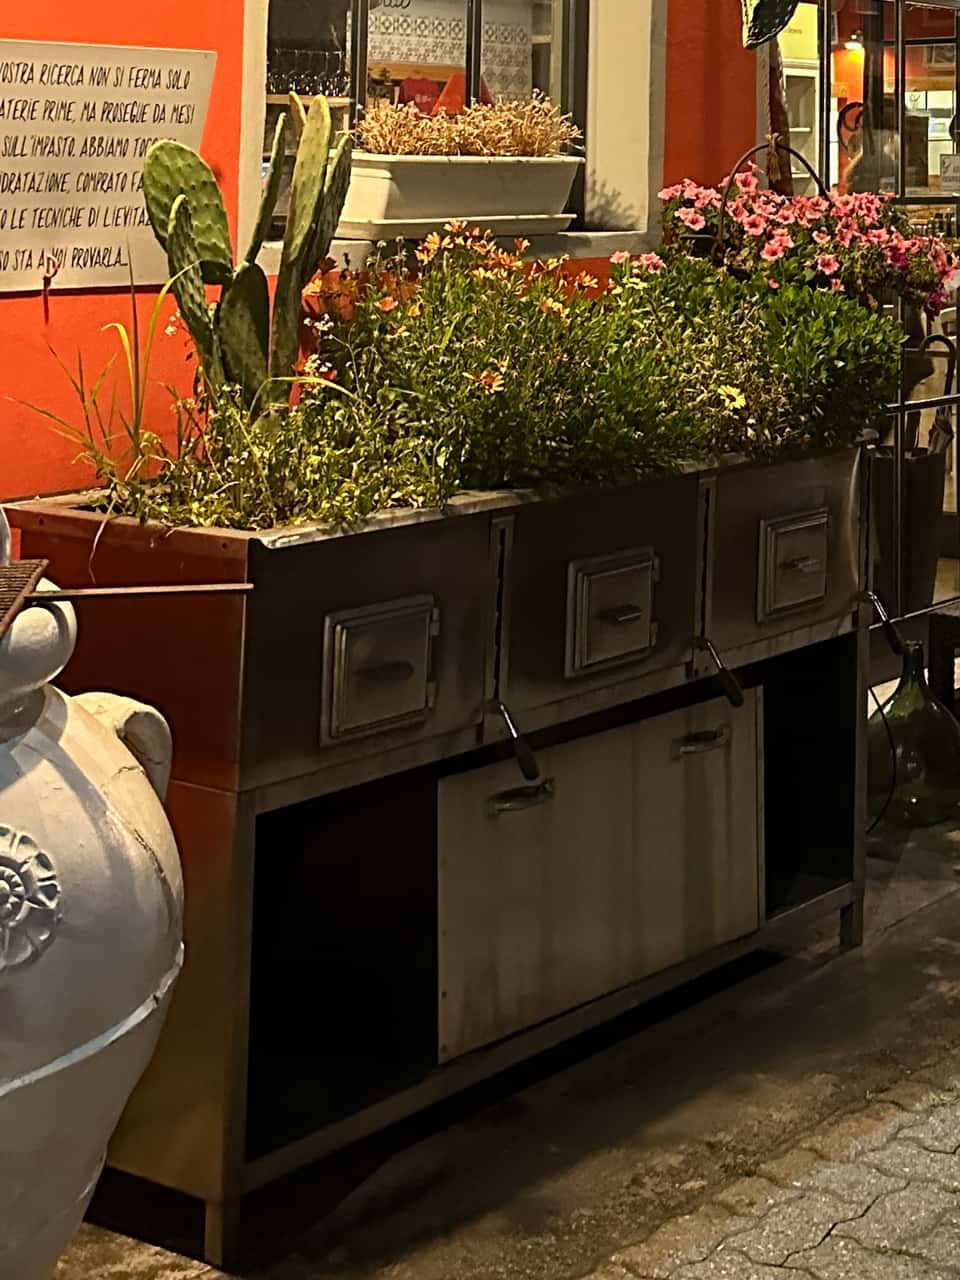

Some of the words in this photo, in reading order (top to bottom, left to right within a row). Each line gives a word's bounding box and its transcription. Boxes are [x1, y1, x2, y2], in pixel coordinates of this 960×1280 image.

[39, 64, 84, 86] RICERCA
[89, 66, 111, 87] NON
[113, 66, 124, 88] SI
[128, 67, 161, 89] FERMA
[166, 68, 191, 90] SOLO
[80, 101, 96, 122] MA
[101, 101, 150, 124] PROSEGUE
[153, 104, 166, 124] DA
[169, 104, 196, 125] MESI
[79, 136, 130, 158] ABBIAMO
[0, 171, 71, 195] DRATAZIONE,
[76, 172, 128, 194] COMPRATO
[11, 207, 28, 230] LE
[32, 206, 85, 229] TECNICHE
[88, 206, 100, 228] DI
[13, 249, 33, 272] STA
[37, 248, 45, 270] A
